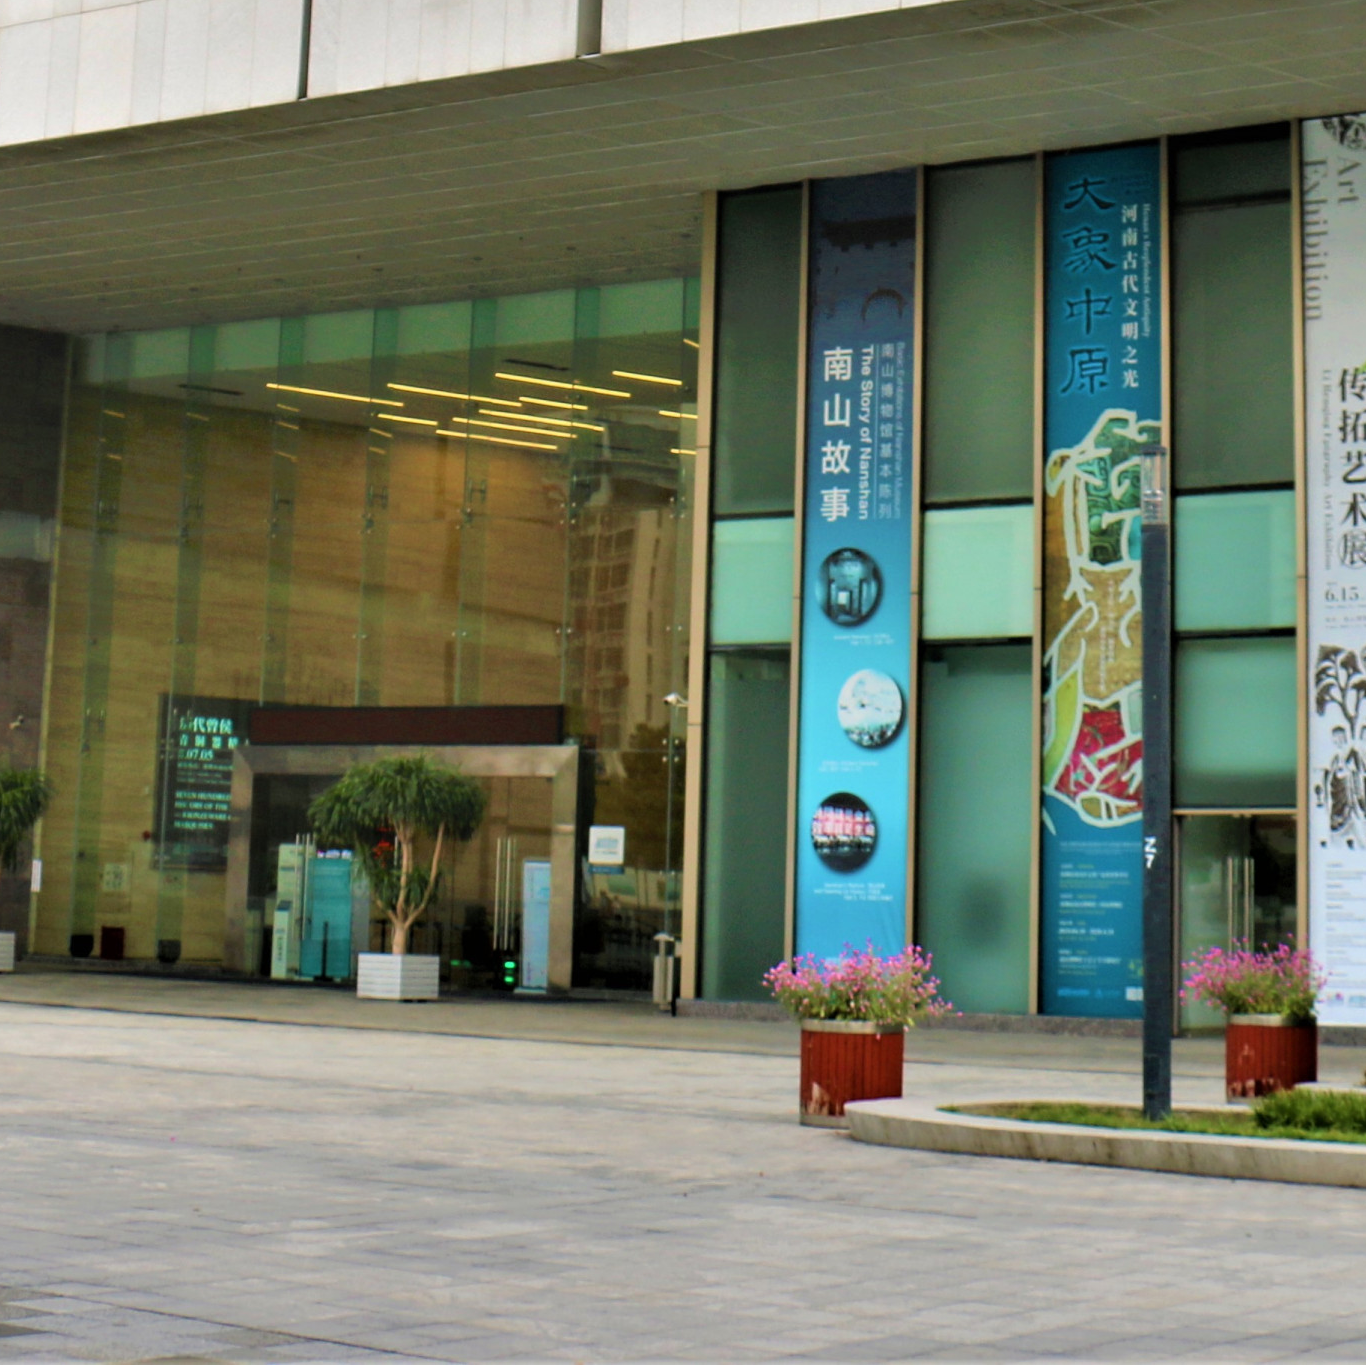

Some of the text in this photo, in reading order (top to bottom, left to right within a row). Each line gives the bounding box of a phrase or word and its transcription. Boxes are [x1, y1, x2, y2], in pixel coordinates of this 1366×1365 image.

[1305, 159, 1328, 320] Exhibition
[1338, 156, 1361, 203] Art
[1060, 177, 1118, 394] 大象中原
[1121, 203, 1139, 388] 河南古代文明之光
[820, 345, 854, 522] 南山故事
[858, 344, 874, 520] The Story of Nanshan
[1324, 585, 1360, 602] 6.15
